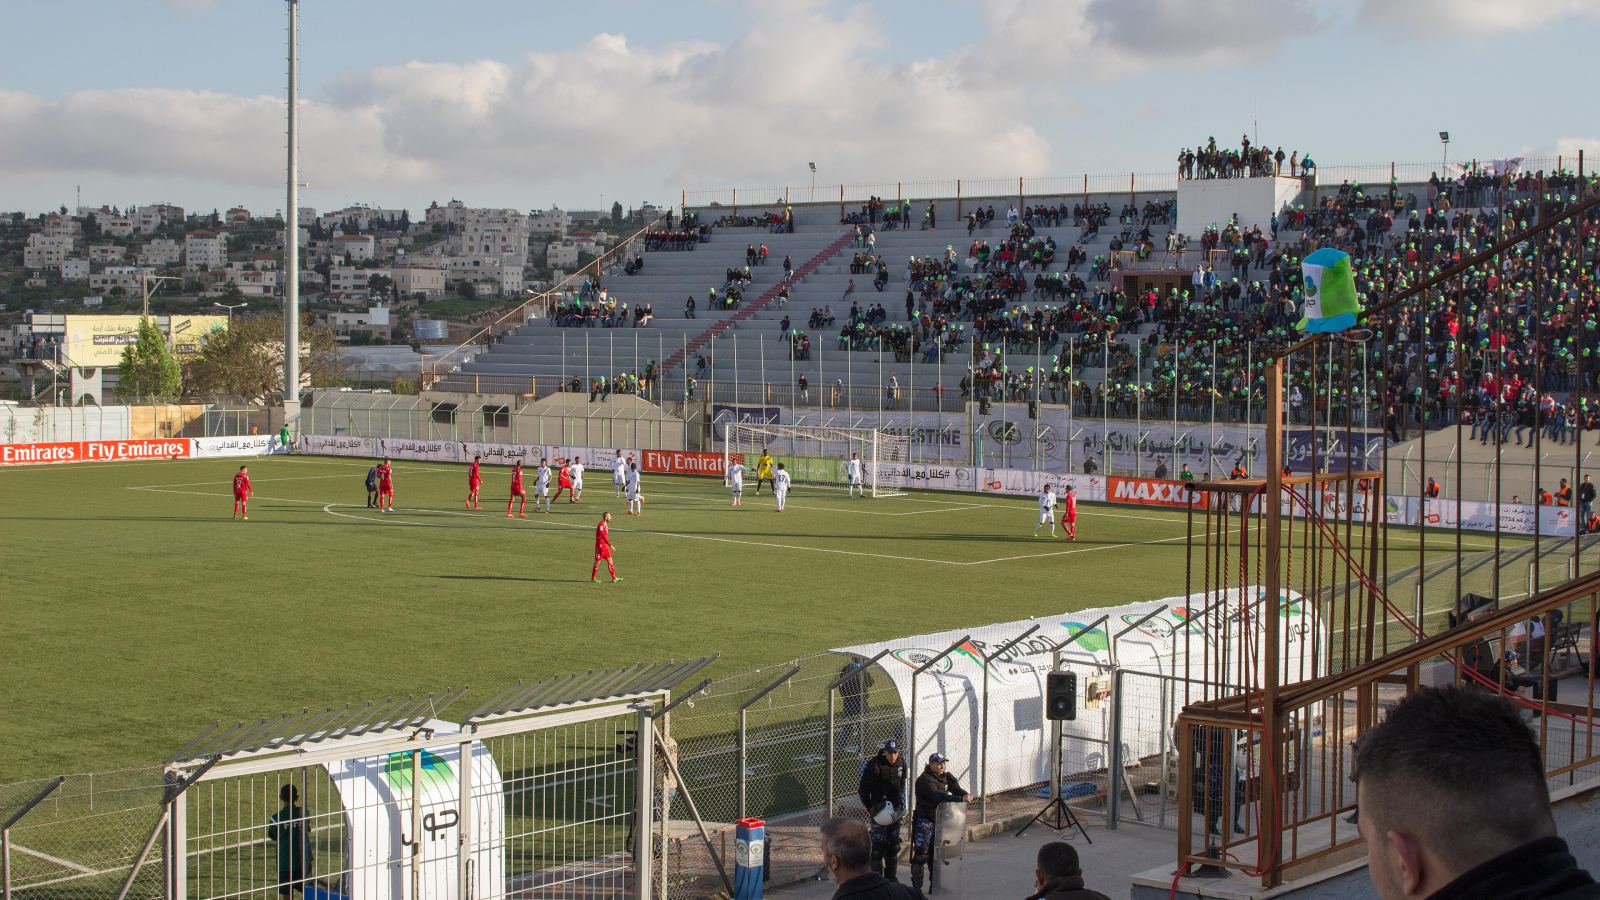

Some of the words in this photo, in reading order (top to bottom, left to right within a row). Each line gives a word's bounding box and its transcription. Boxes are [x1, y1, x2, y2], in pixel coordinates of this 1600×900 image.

[3, 445, 75, 461] Emirates
[88, 443, 115, 460] Fly
[118, 441, 184, 457] Emirates
[648, 453, 671, 472] Fly
